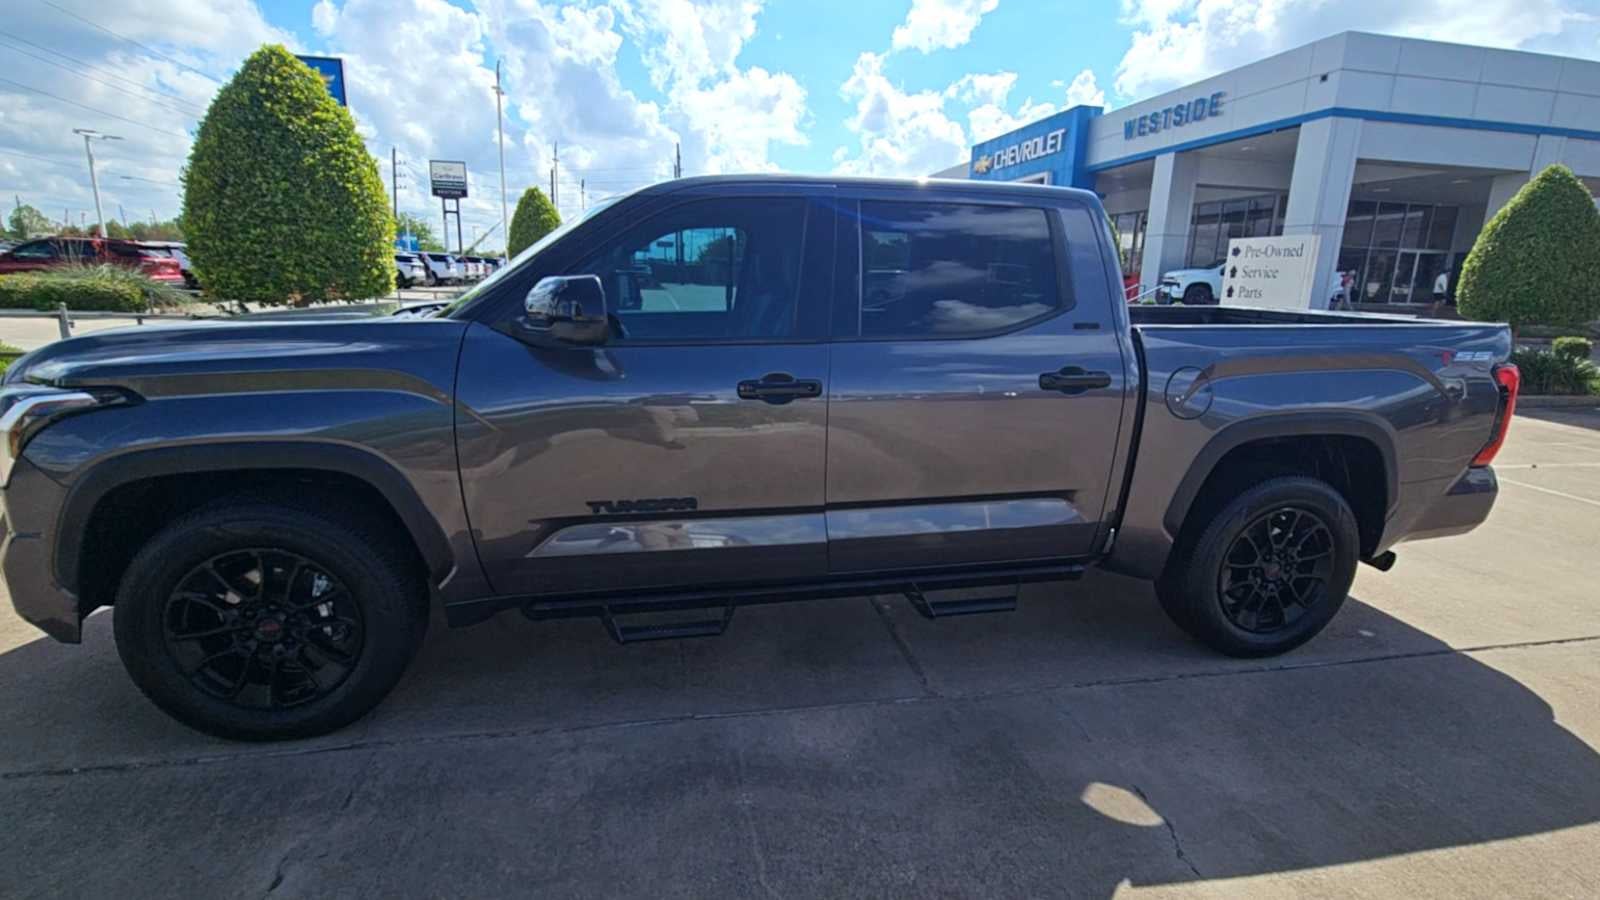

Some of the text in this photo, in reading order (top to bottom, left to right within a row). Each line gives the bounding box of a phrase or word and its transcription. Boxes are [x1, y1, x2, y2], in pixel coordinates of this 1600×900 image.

[1123, 92, 1227, 140] WESTSIDE
[994, 129, 1066, 169] CHEVROLET
[1244, 243, 1304, 258] Pre-Owned
[1241, 265, 1279, 279] Service
[1238, 286, 1263, 299] Parts
[585, 497, 698, 514] TUNDRA
